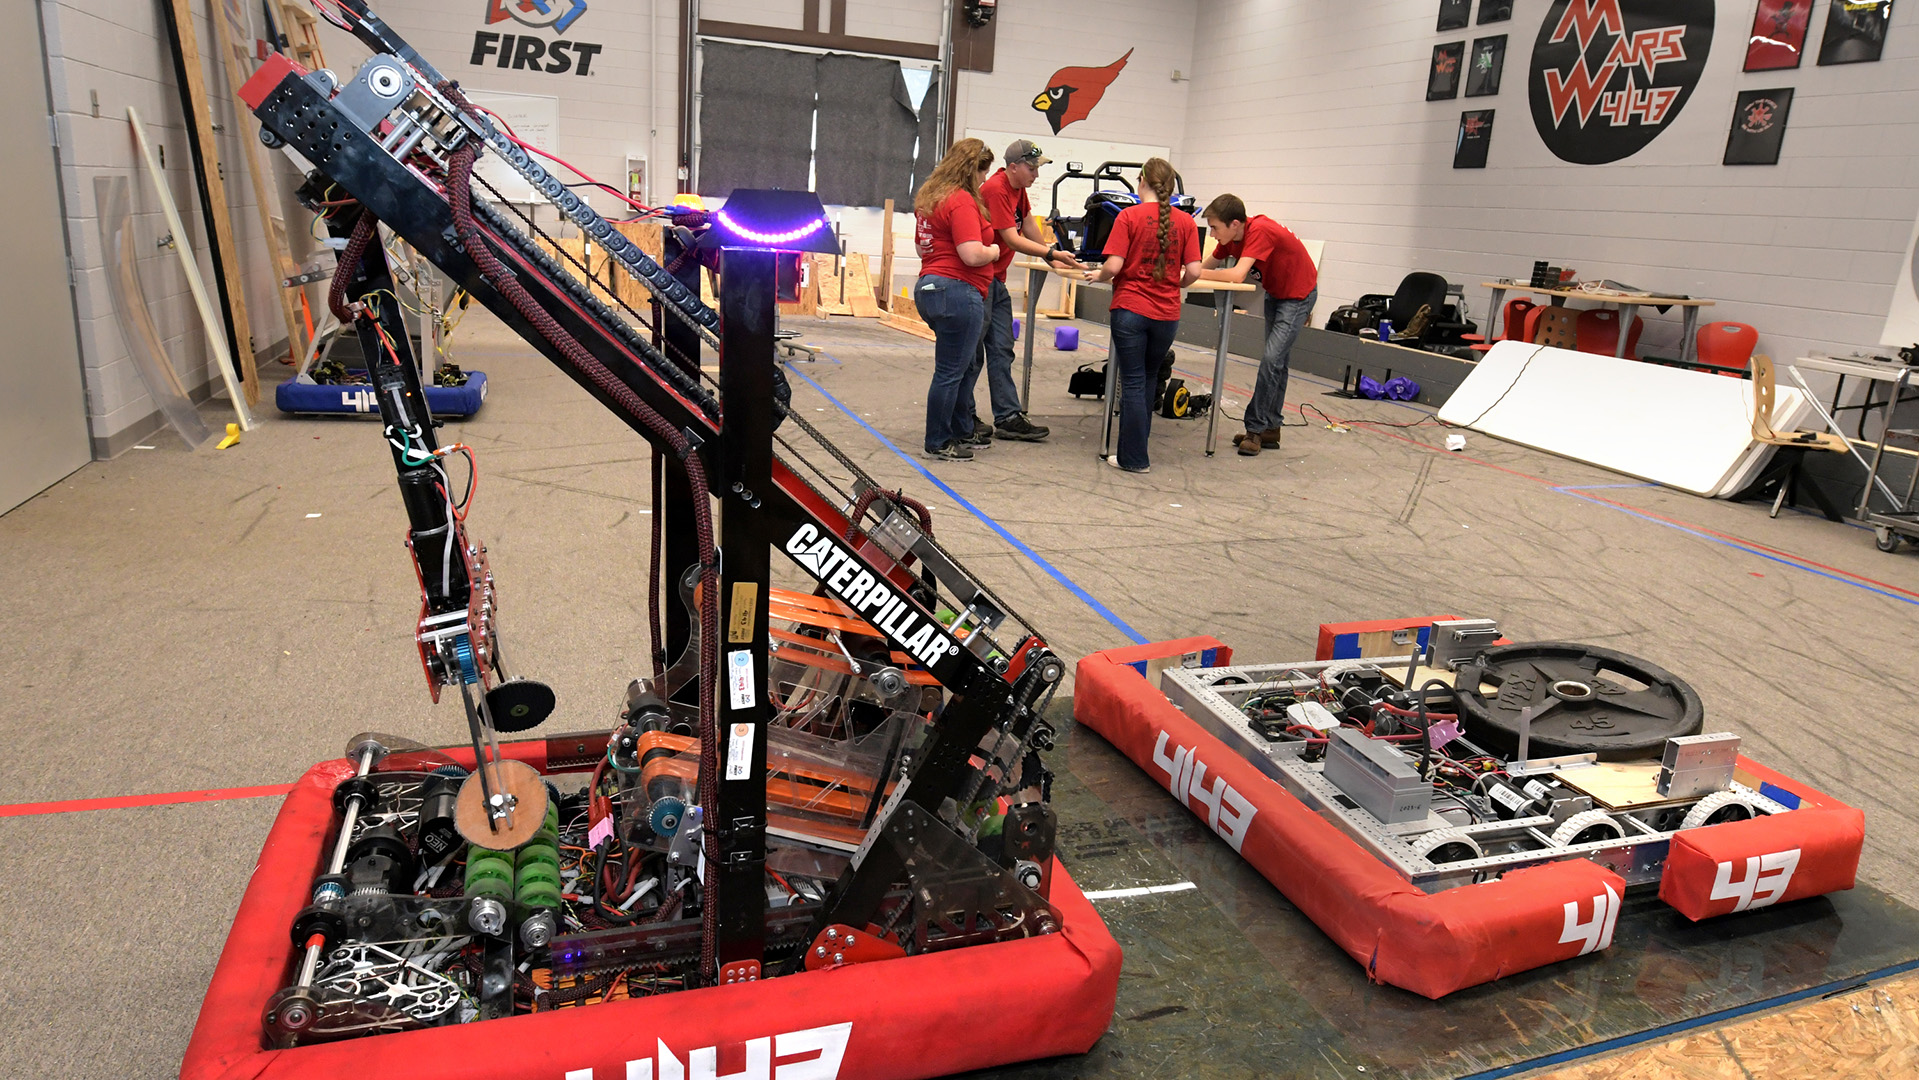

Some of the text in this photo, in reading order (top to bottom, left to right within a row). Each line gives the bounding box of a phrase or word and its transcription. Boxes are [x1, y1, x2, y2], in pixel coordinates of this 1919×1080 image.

[470, 30, 602, 76] FIRST
[1569, 713, 1616, 731] 45
[1153, 729, 1258, 854] 4143
[425, 834, 447, 852] NEO
[1709, 848, 1801, 914] 43
[1557, 880, 1621, 956] 41
